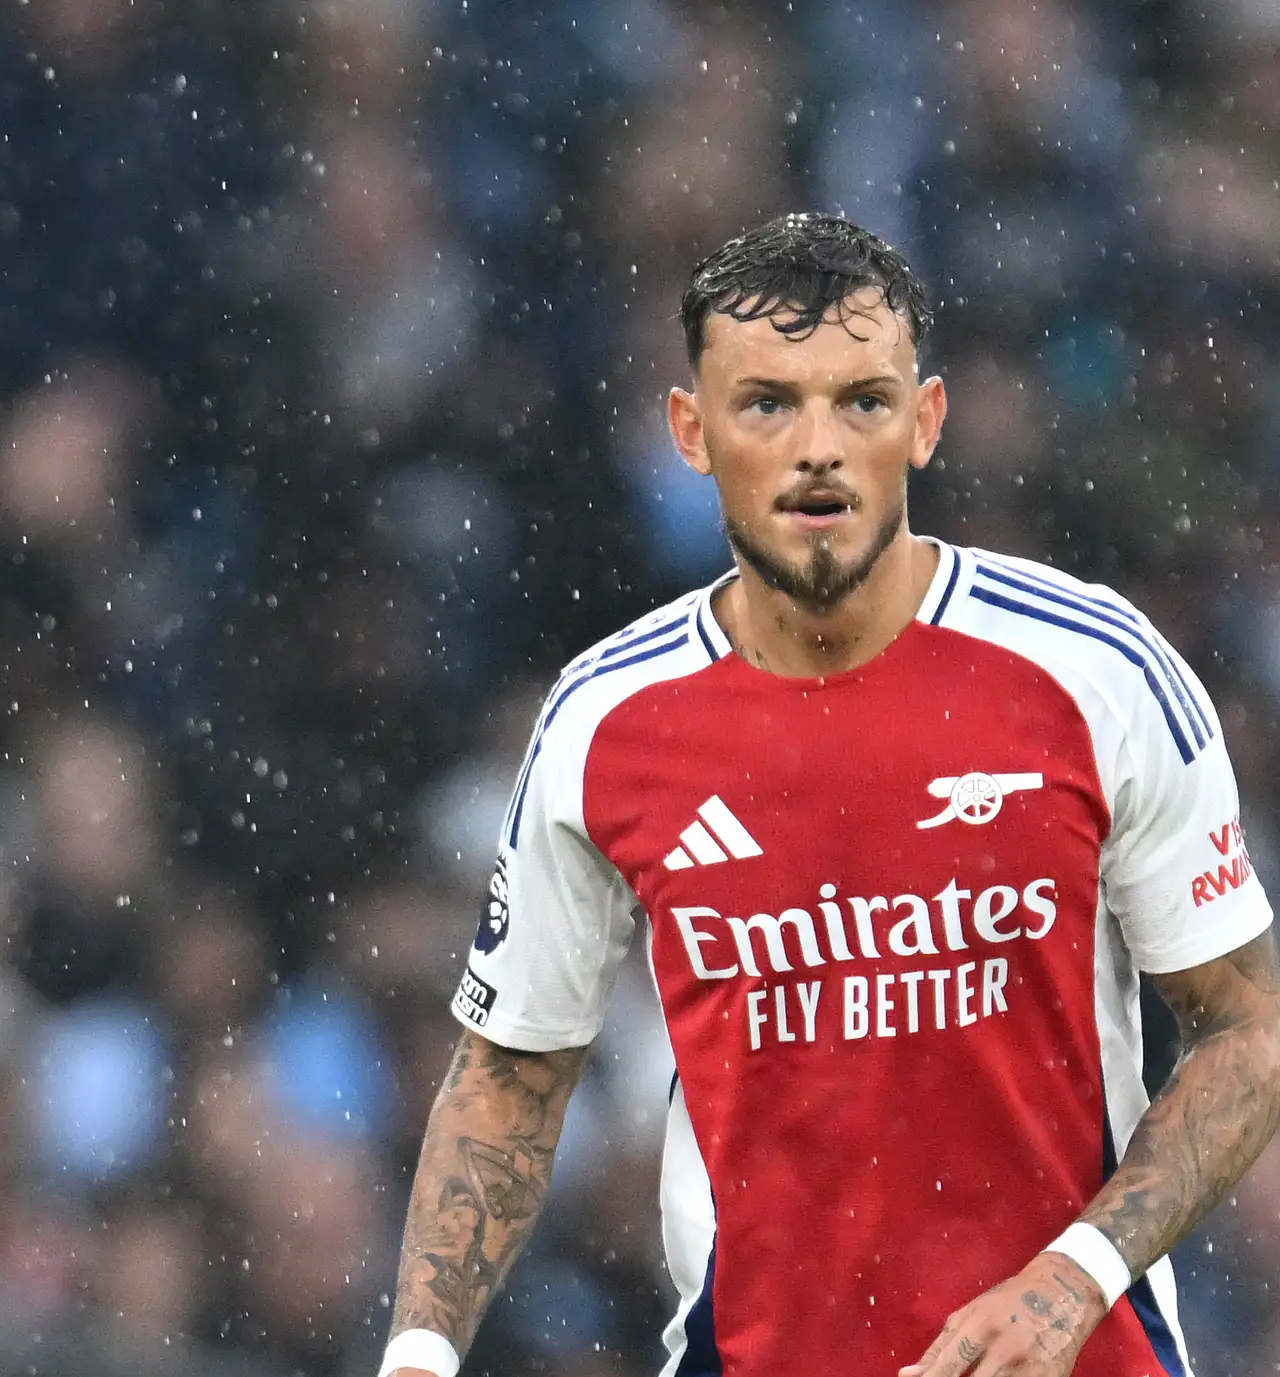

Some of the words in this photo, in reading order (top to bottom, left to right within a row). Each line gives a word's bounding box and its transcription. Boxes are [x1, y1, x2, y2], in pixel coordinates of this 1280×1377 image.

[670, 877, 1057, 980] Emirates
[747, 980, 823, 1051] FLY
[844, 957, 1009, 1041] BETTER
